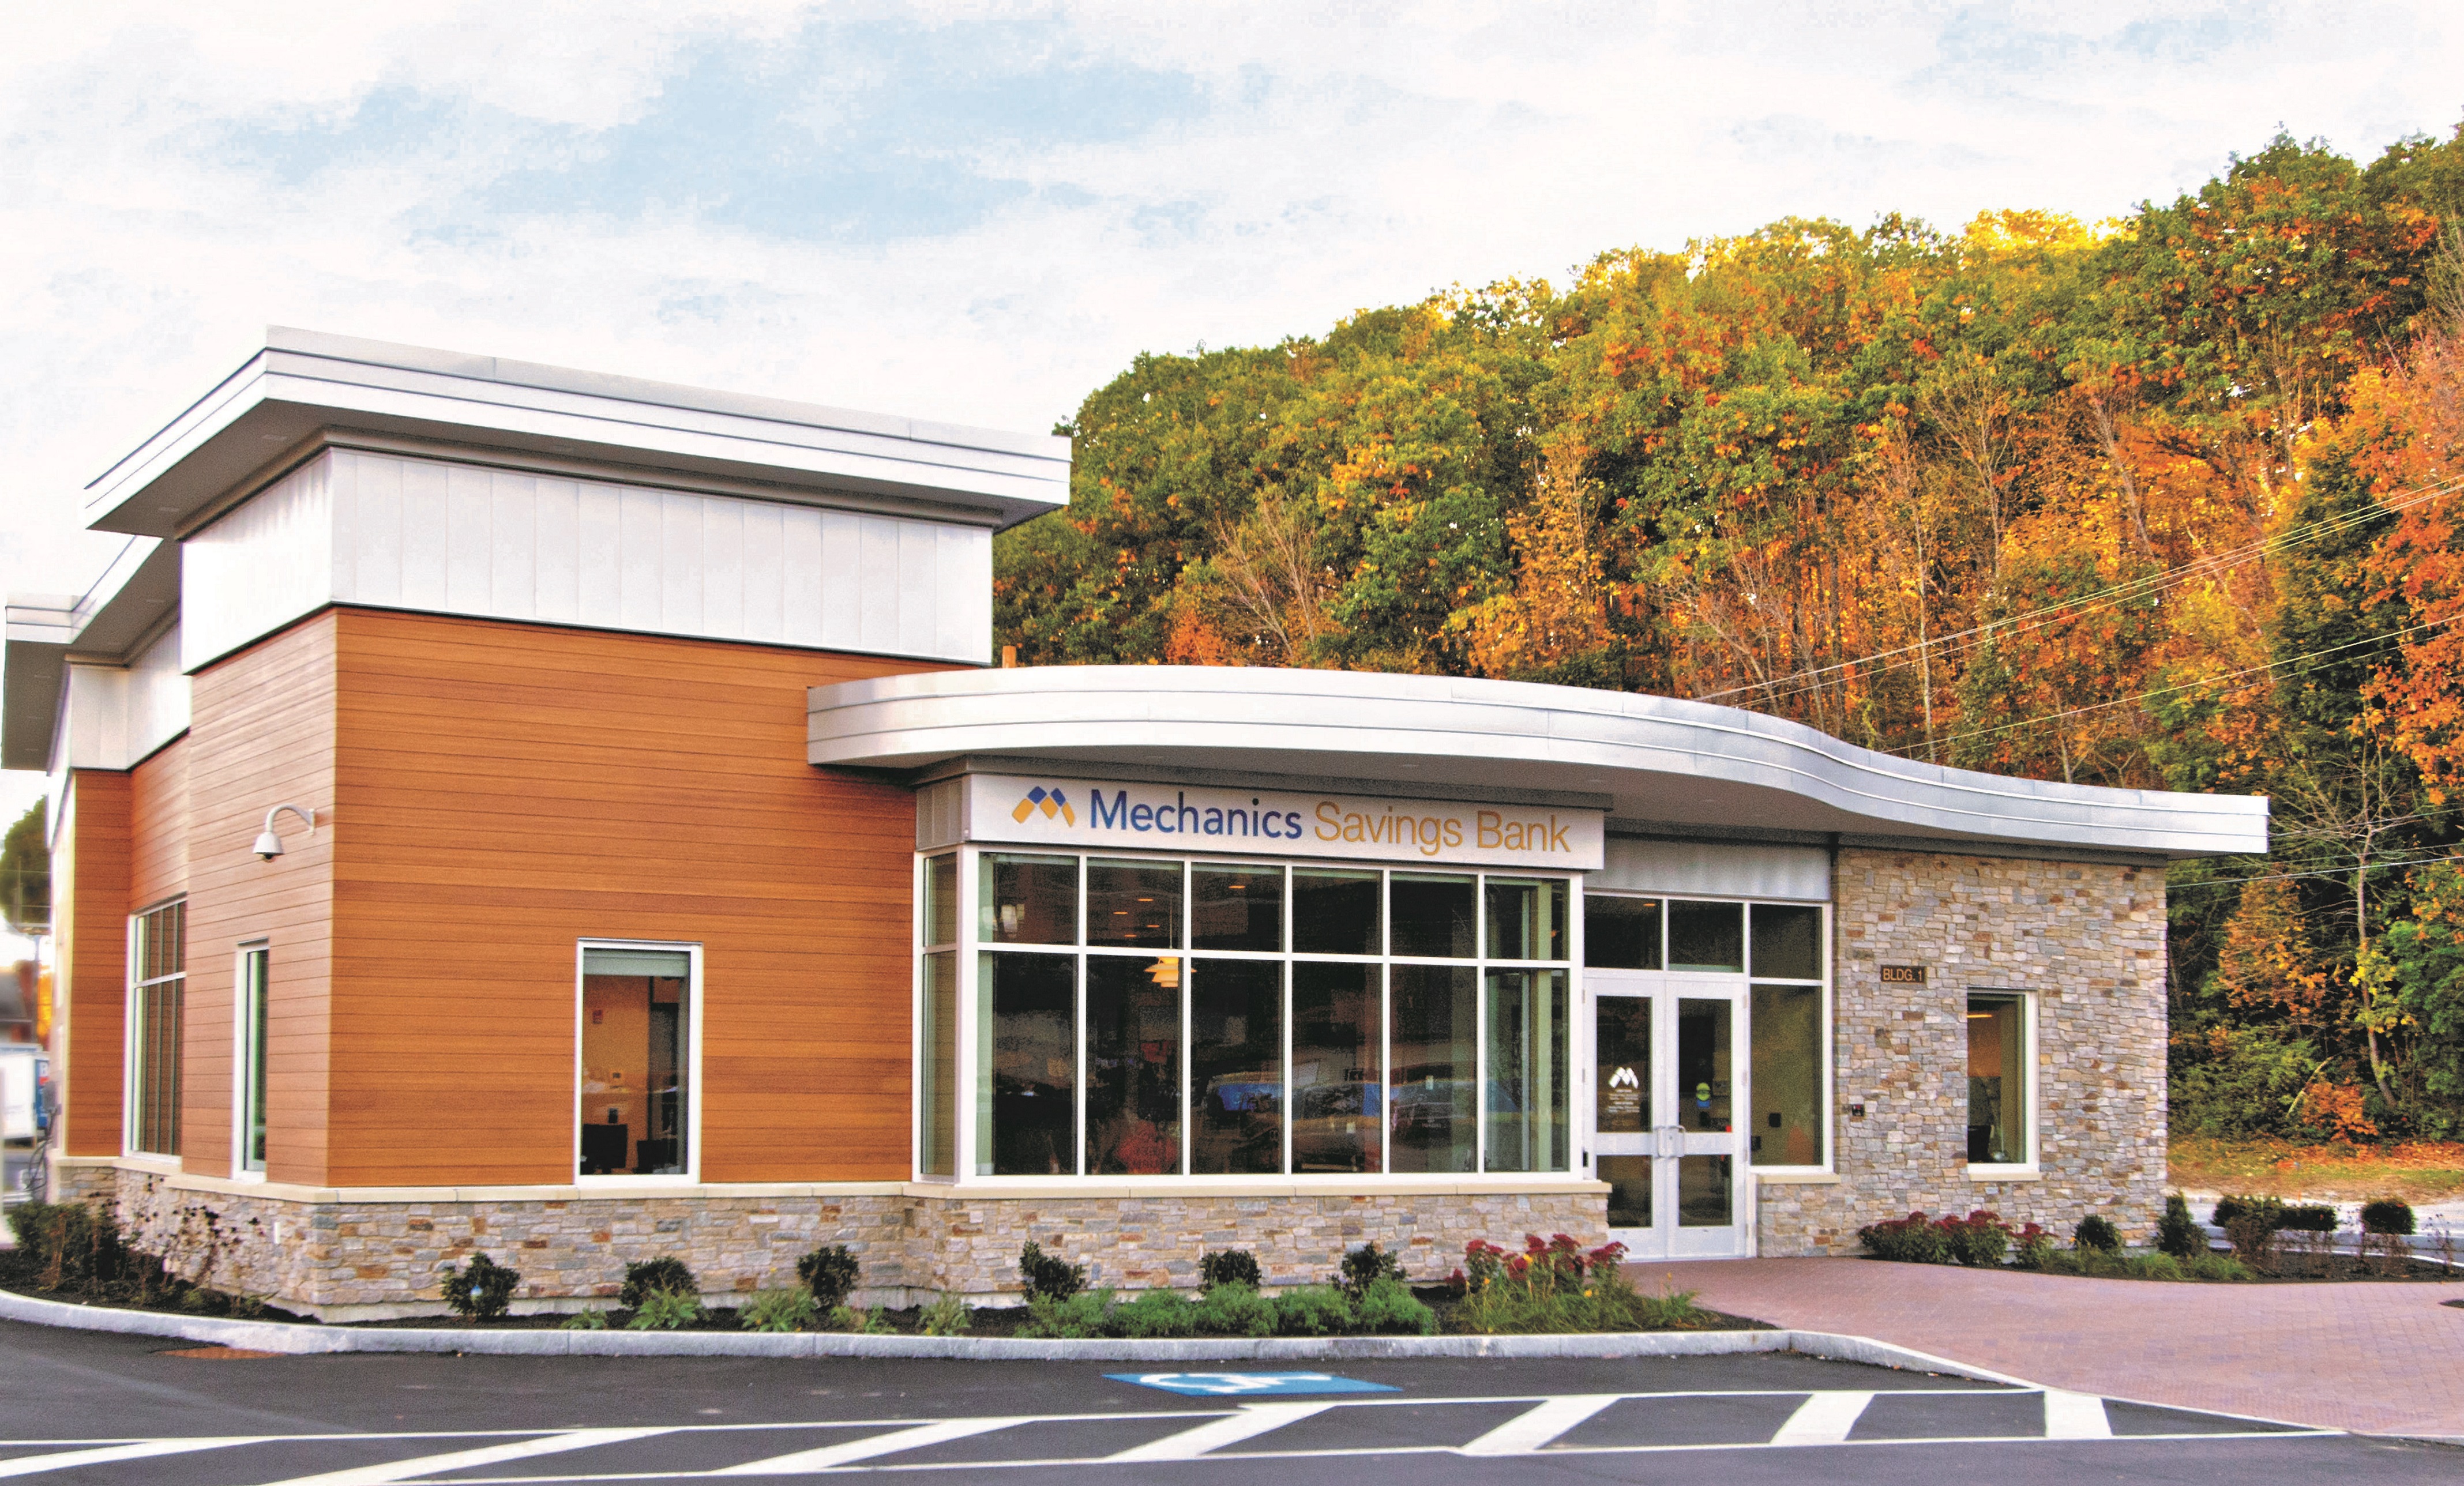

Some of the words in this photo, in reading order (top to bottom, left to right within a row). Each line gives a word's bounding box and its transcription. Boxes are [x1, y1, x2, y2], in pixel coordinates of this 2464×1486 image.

[1090, 789, 1302, 839] Mechanics
[1314, 802, 1463, 855] Savings
[1477, 811, 1571, 852] Bank
[1883, 968, 1915, 981] BLDG.
[1918, 969, 1923, 981] 1
